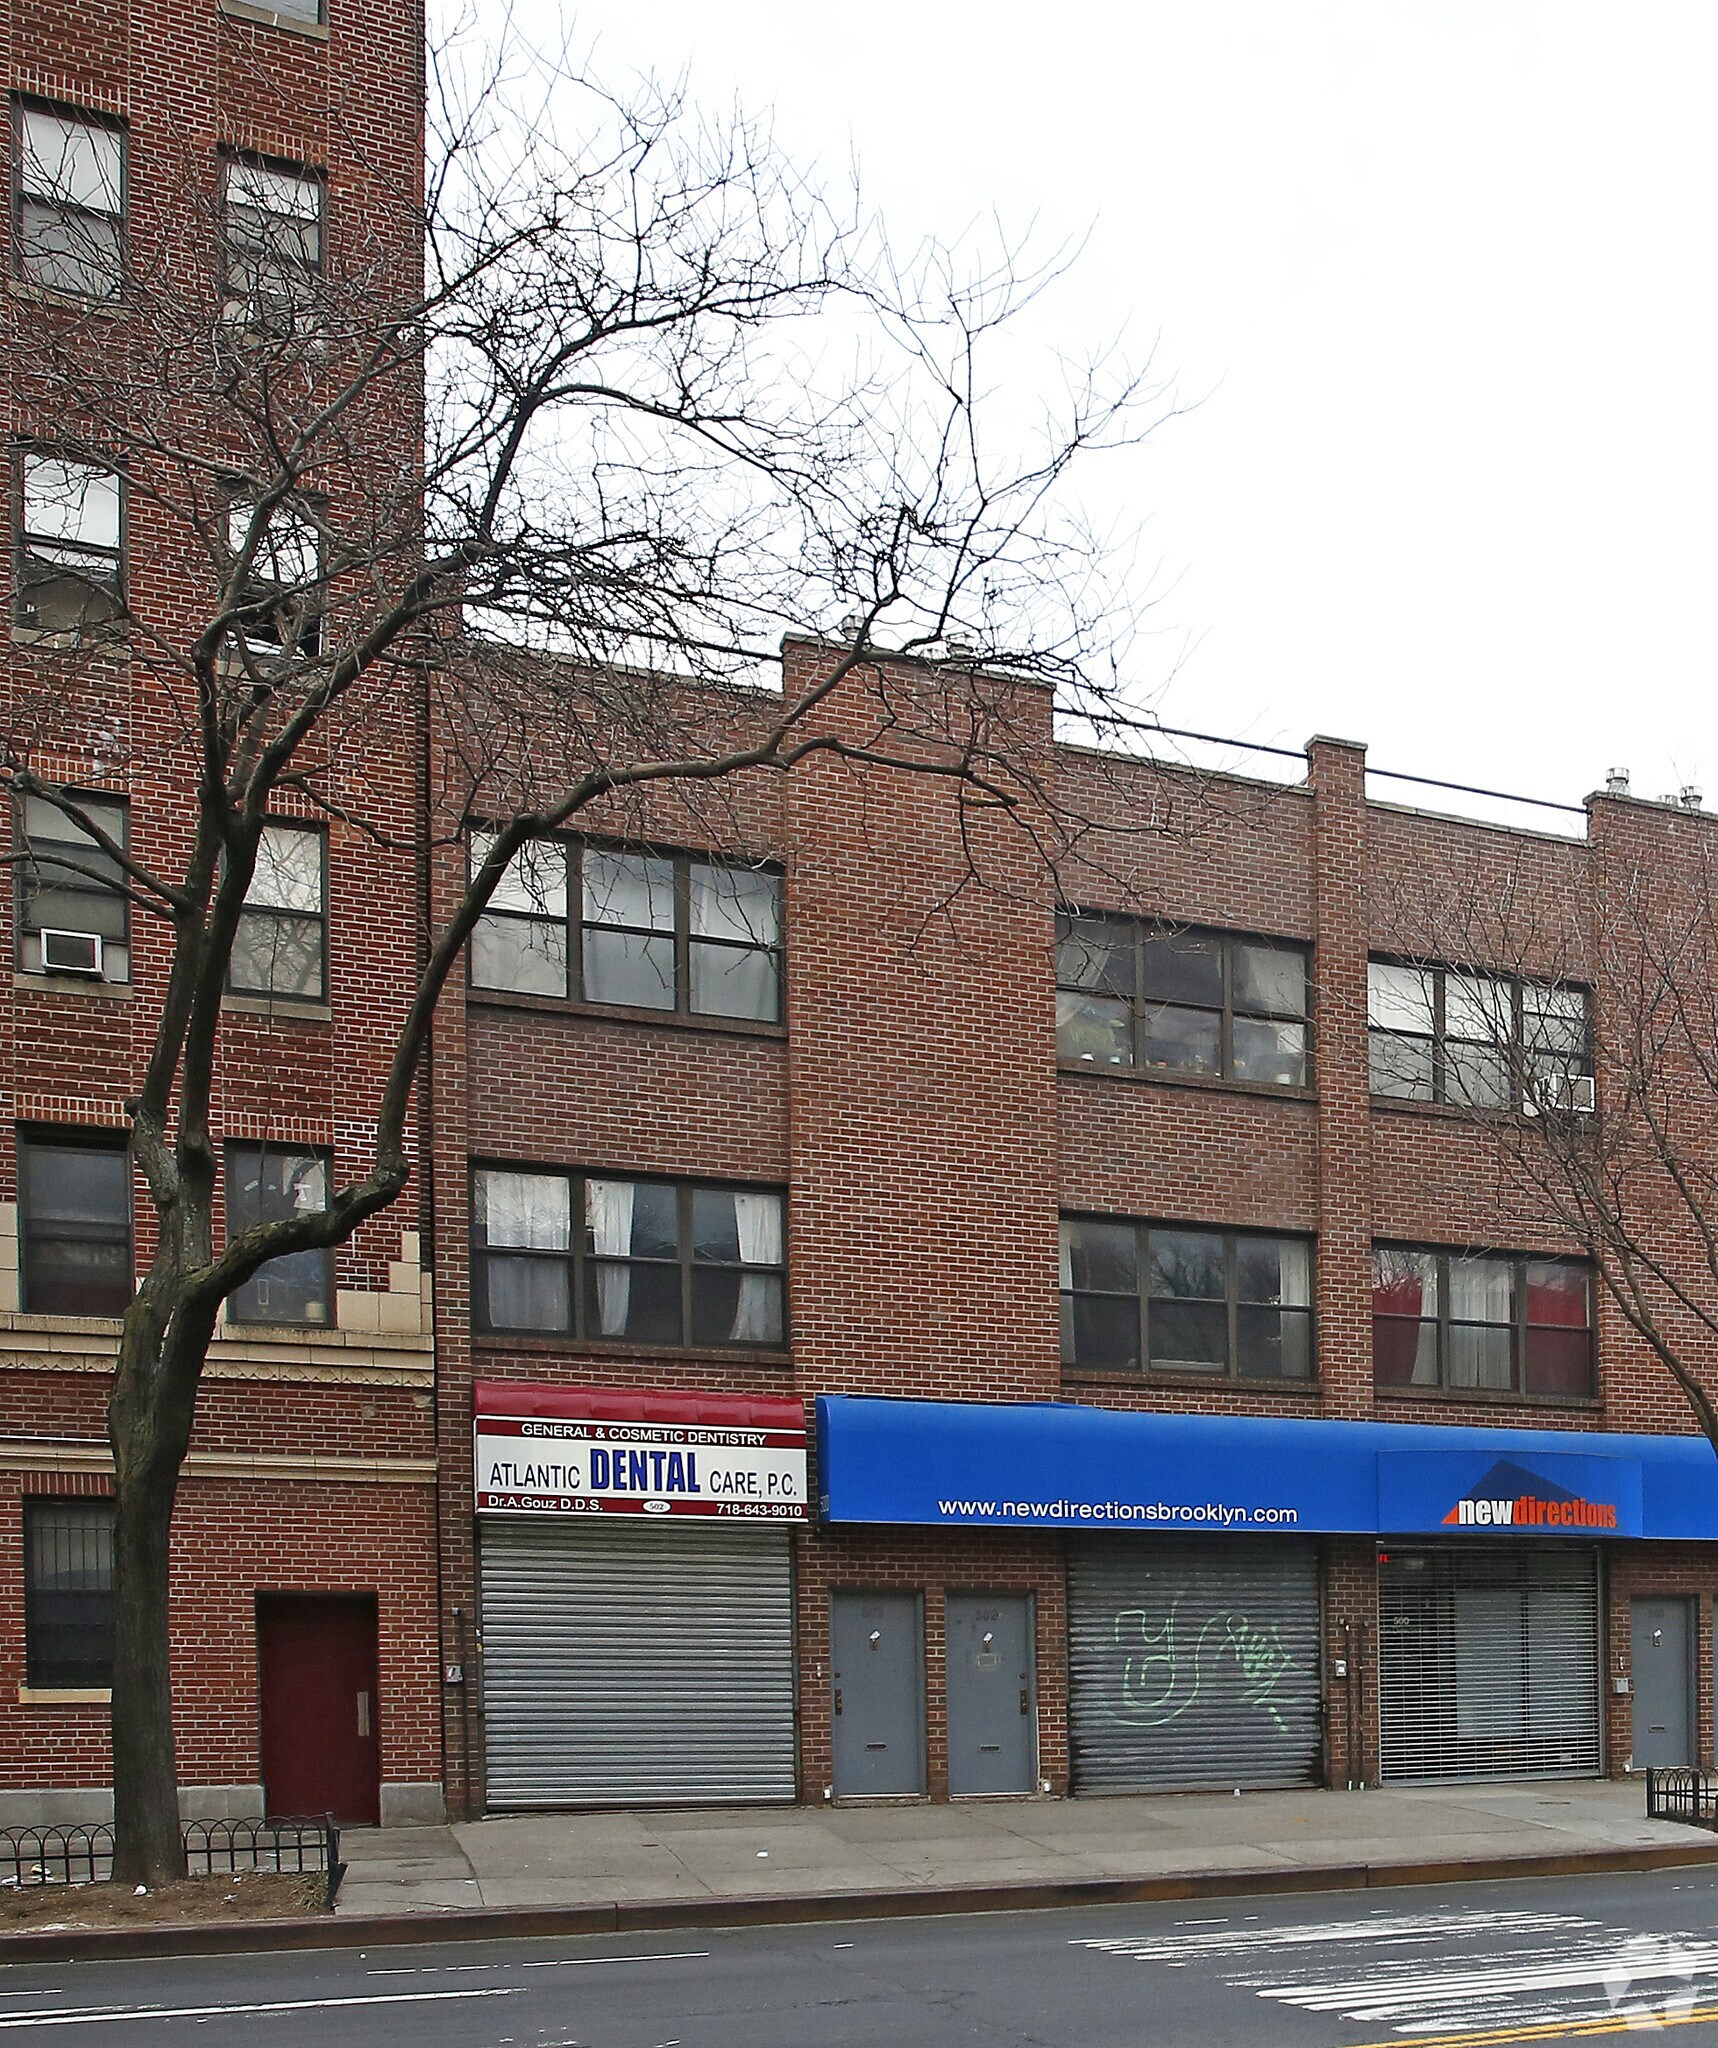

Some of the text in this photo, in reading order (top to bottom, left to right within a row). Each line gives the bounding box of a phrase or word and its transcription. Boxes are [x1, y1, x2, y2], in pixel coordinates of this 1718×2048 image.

[521, 1423, 767, 1446] GENERAL & COSMETIC DENTISTRY
[489, 1447, 798, 1498] ATLANTIC DENTAL CARE, P.C.
[560, 1498, 603, 1511] D.D.S.
[649, 1502, 665, 1511] 502
[716, 1503, 803, 1517] 718-643-9010
[938, 1499, 1299, 1527] www.newdirectionsbrooklyn.com
[1393, 1616, 1410, 1625] 500
